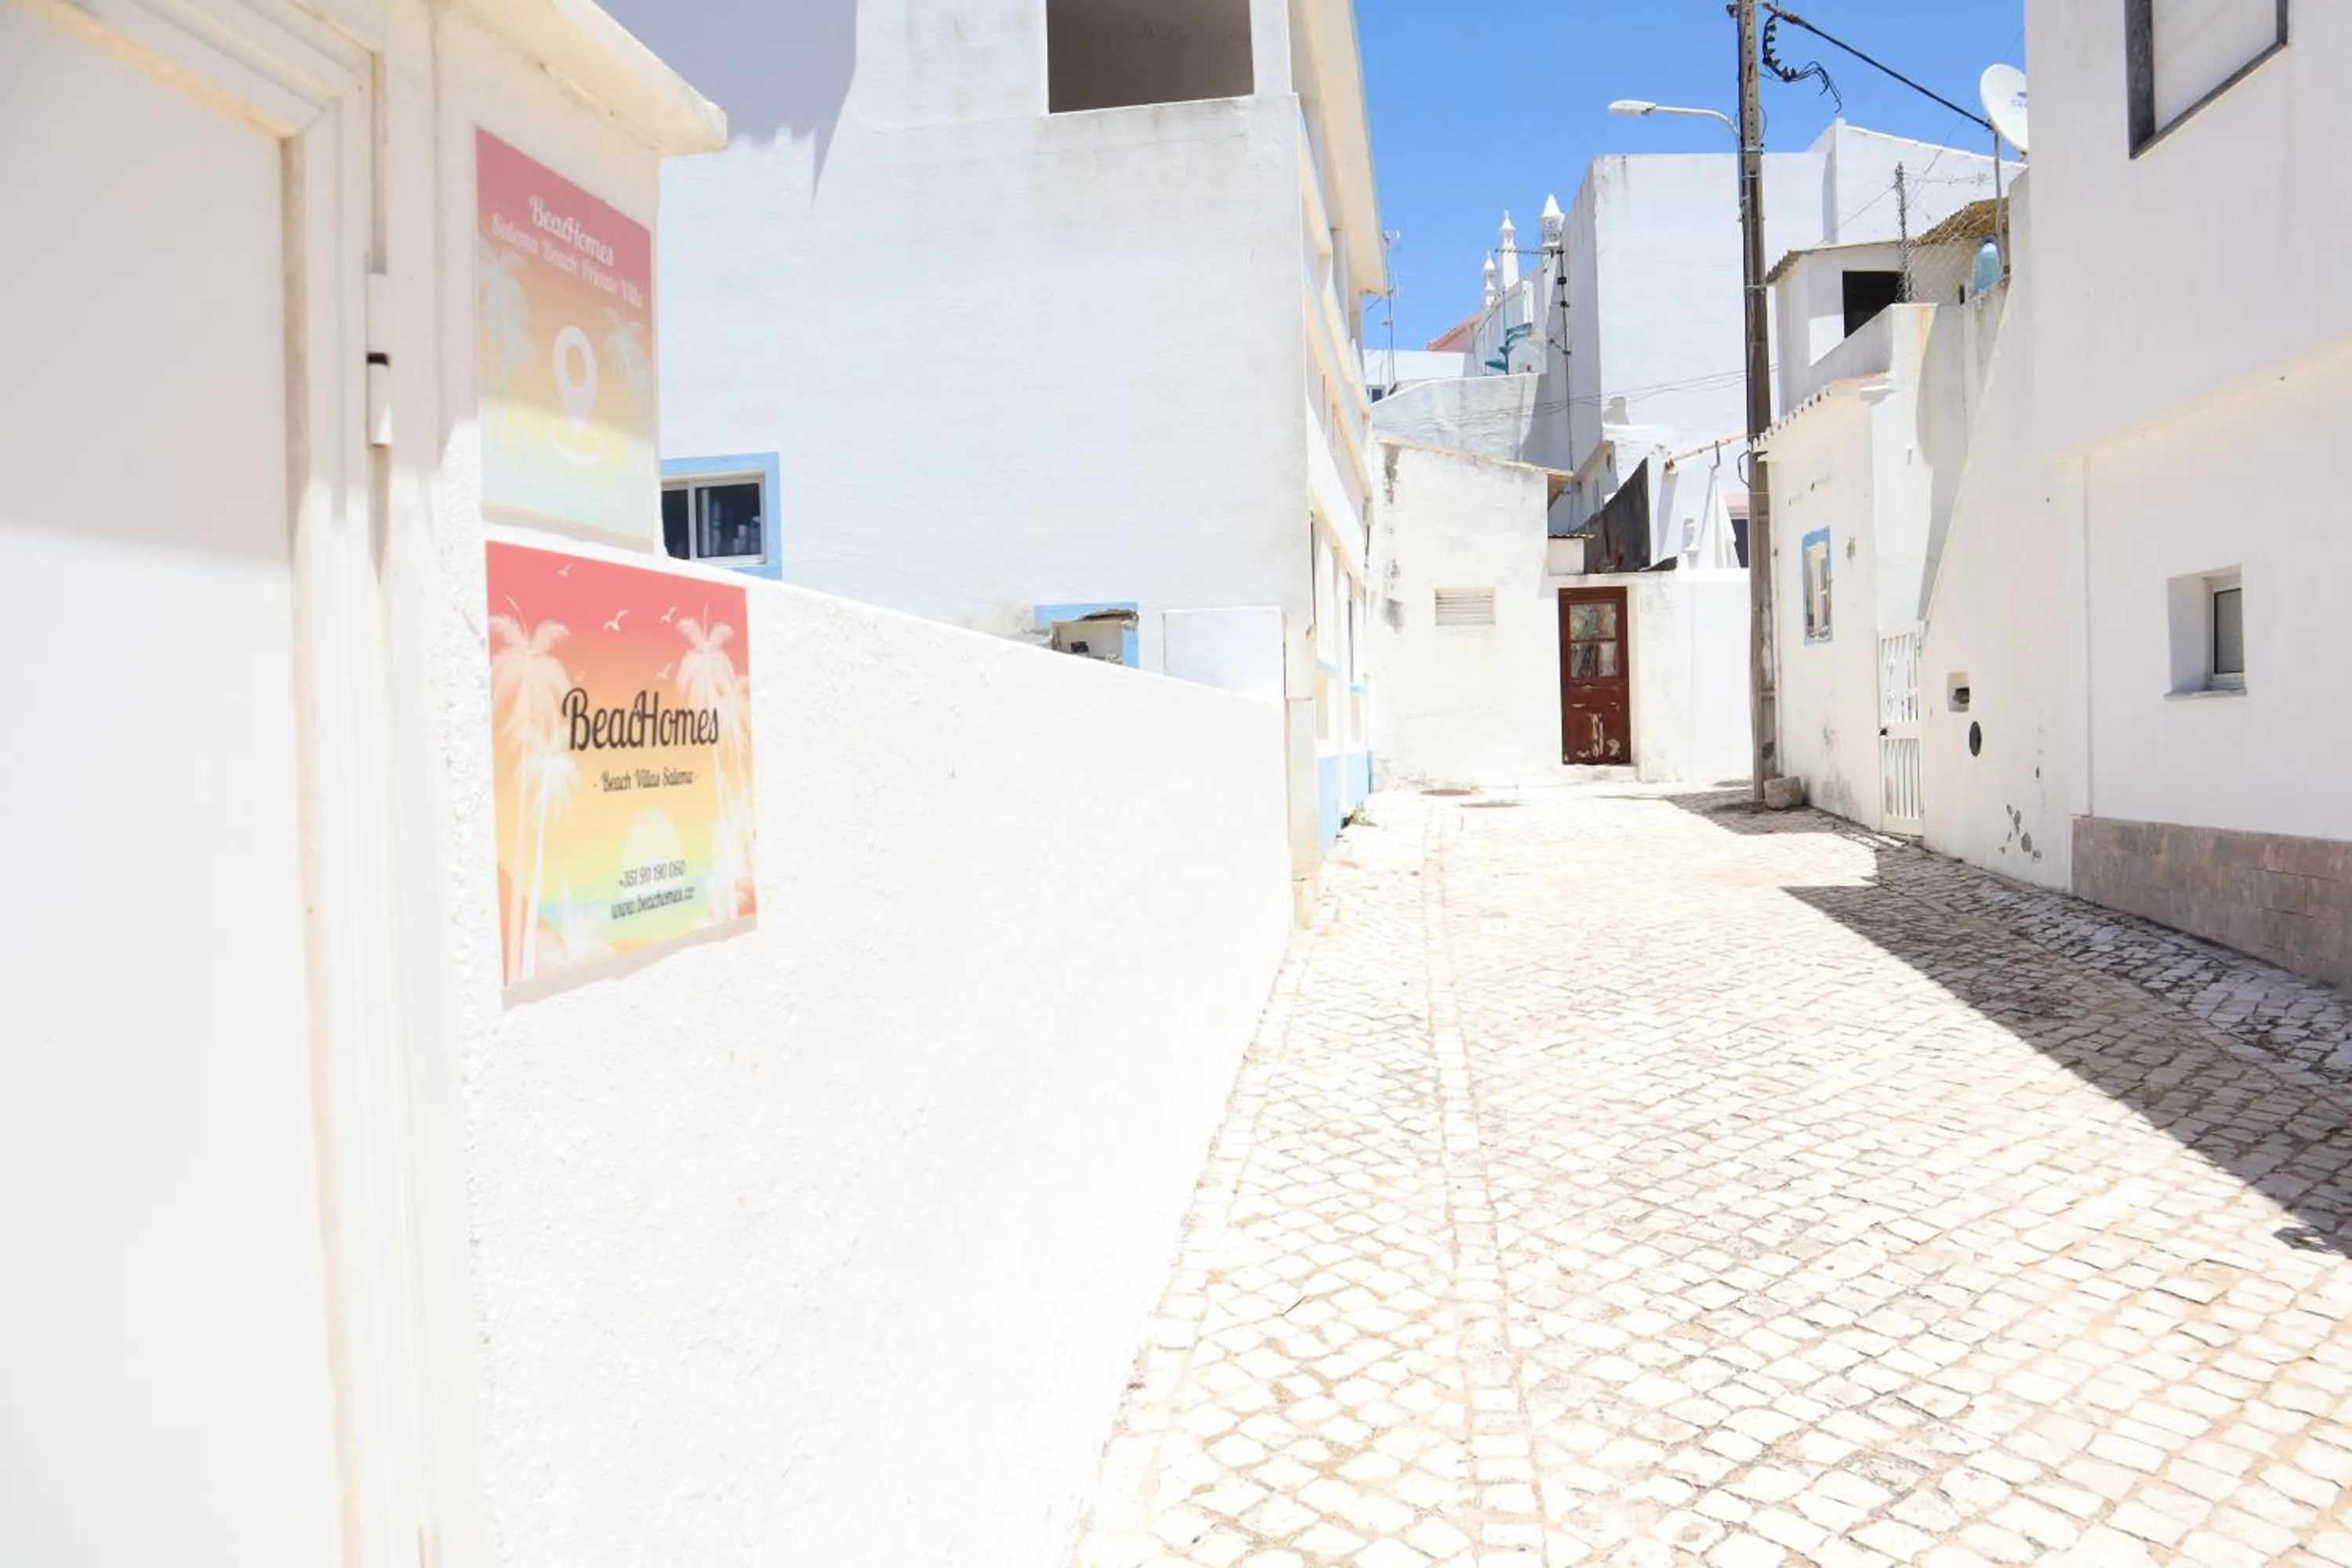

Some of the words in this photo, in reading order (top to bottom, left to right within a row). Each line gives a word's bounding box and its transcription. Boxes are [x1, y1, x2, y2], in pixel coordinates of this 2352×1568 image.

[601, 771, 631, 793] Beach
[635, 768, 659, 789] Villas
[662, 766, 693, 786] Salema
[619, 868, 637, 888] +351
